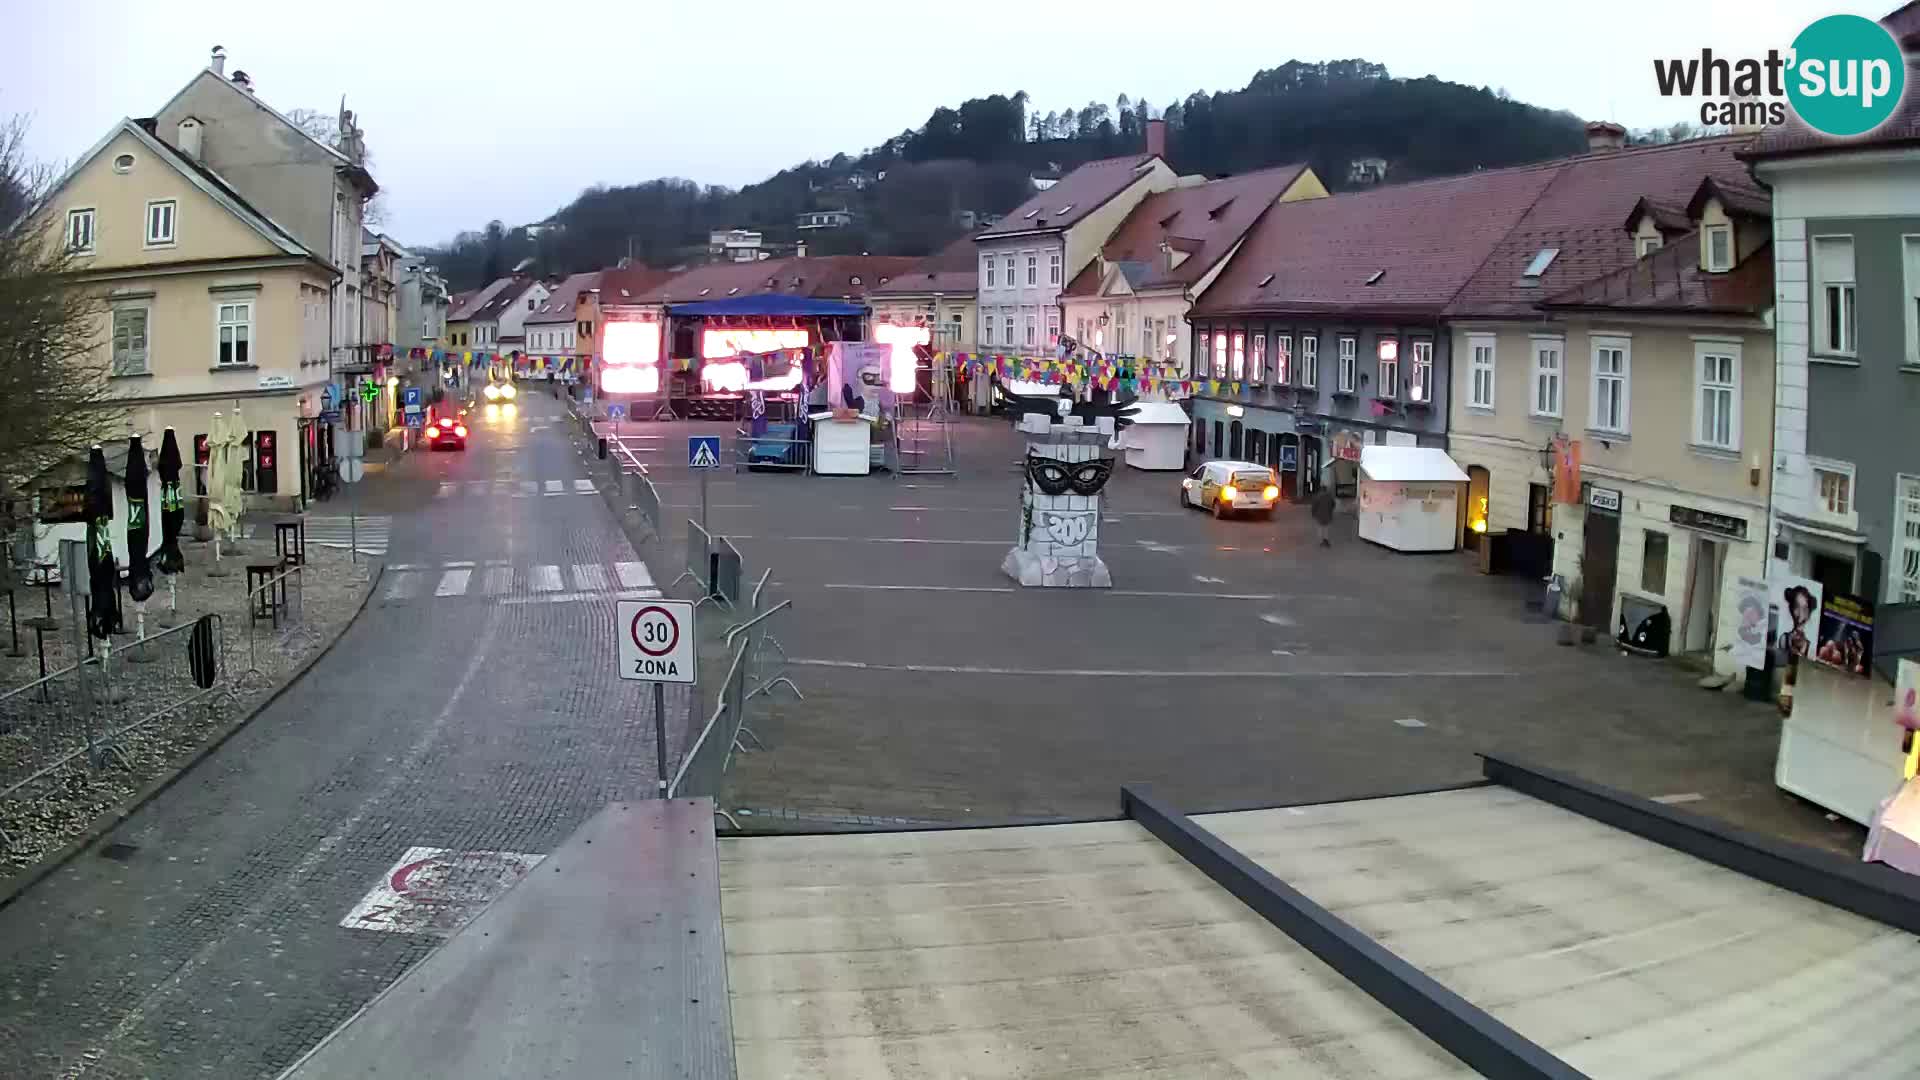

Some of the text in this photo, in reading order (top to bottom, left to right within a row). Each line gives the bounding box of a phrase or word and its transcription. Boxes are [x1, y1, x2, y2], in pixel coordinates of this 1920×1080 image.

[1048, 515, 1088, 545] 200
[643, 621, 668, 643] 30
[634, 659, 679, 676] ZONA
